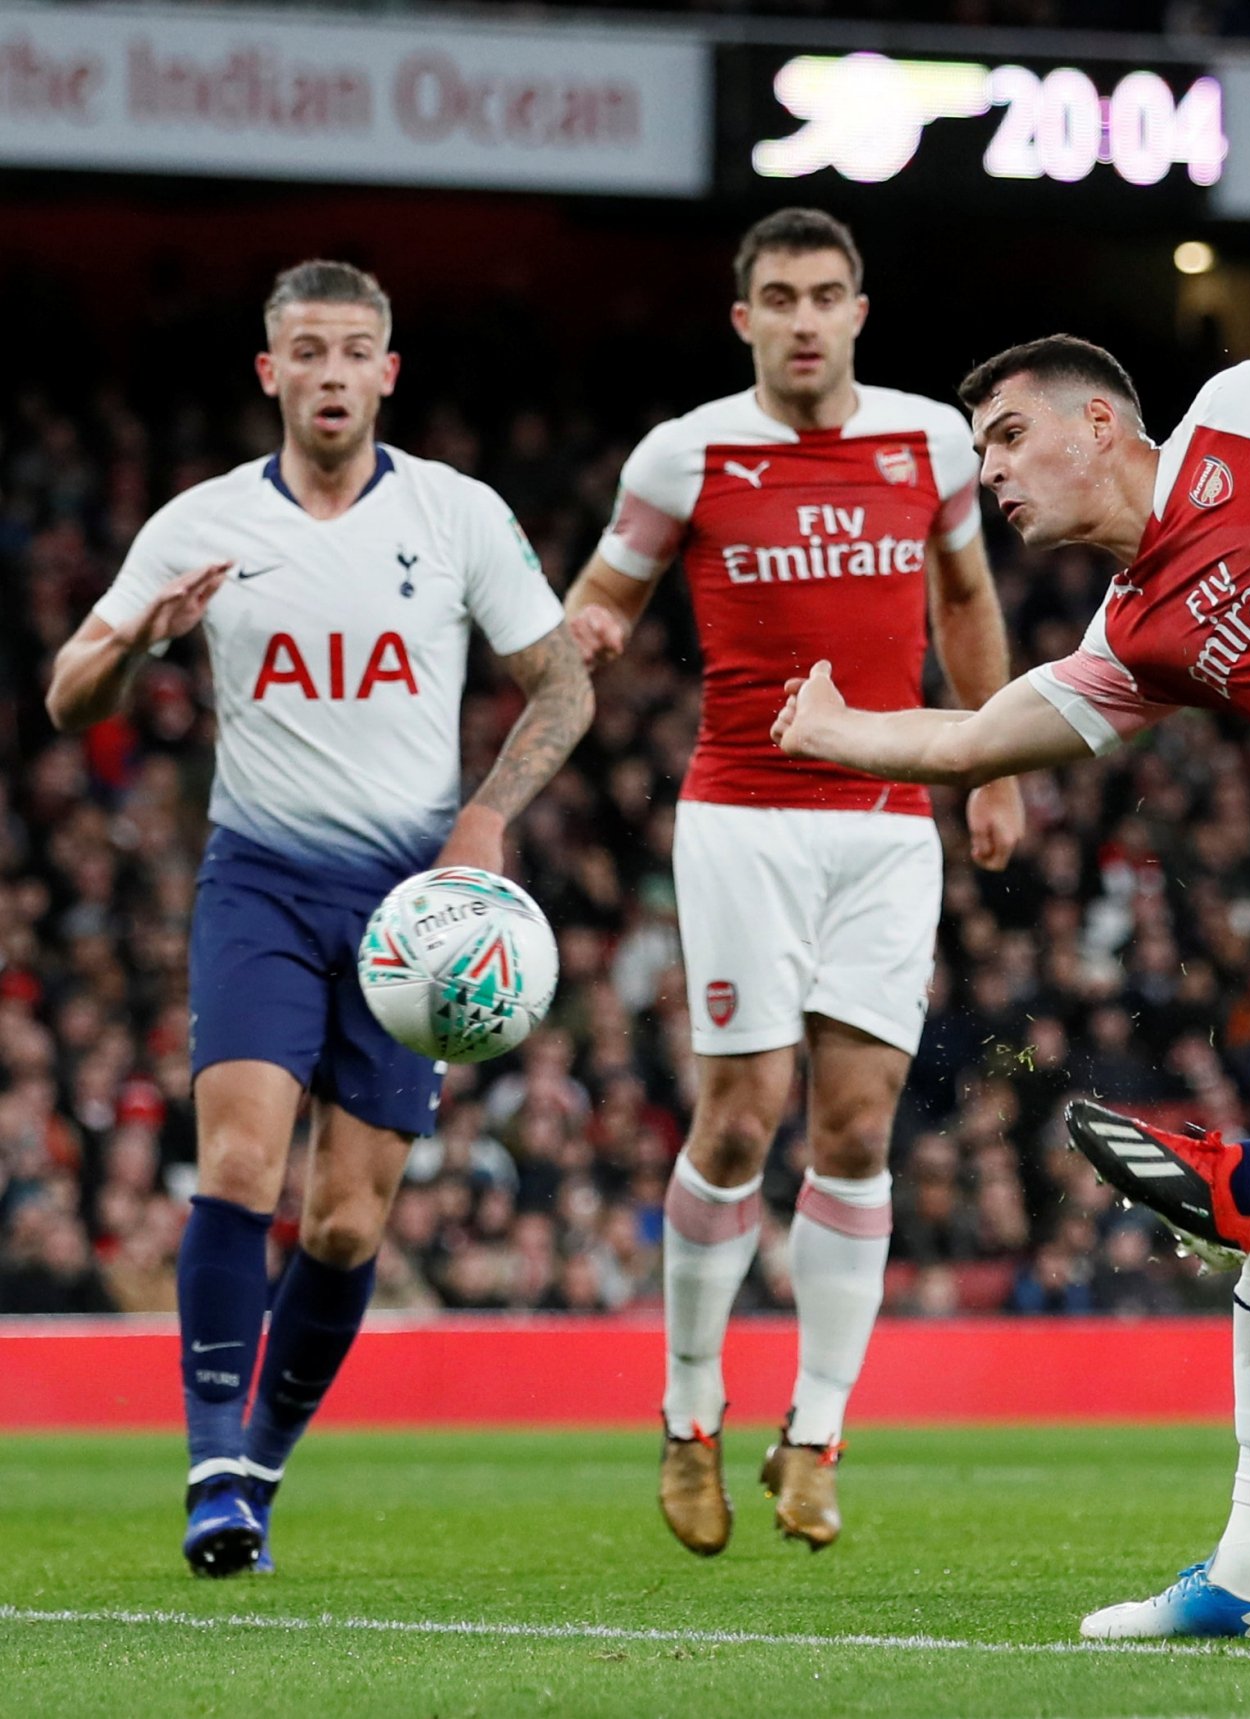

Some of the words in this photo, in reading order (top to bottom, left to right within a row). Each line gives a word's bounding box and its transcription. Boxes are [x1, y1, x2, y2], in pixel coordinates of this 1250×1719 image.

[124, 34, 373, 137] Indian
[395, 50, 642, 148] Ocean
[797, 504, 866, 539] Fly
[1185, 561, 1238, 626] Fly
[253, 631, 419, 700] AIA
[413, 900, 489, 938] mitre
